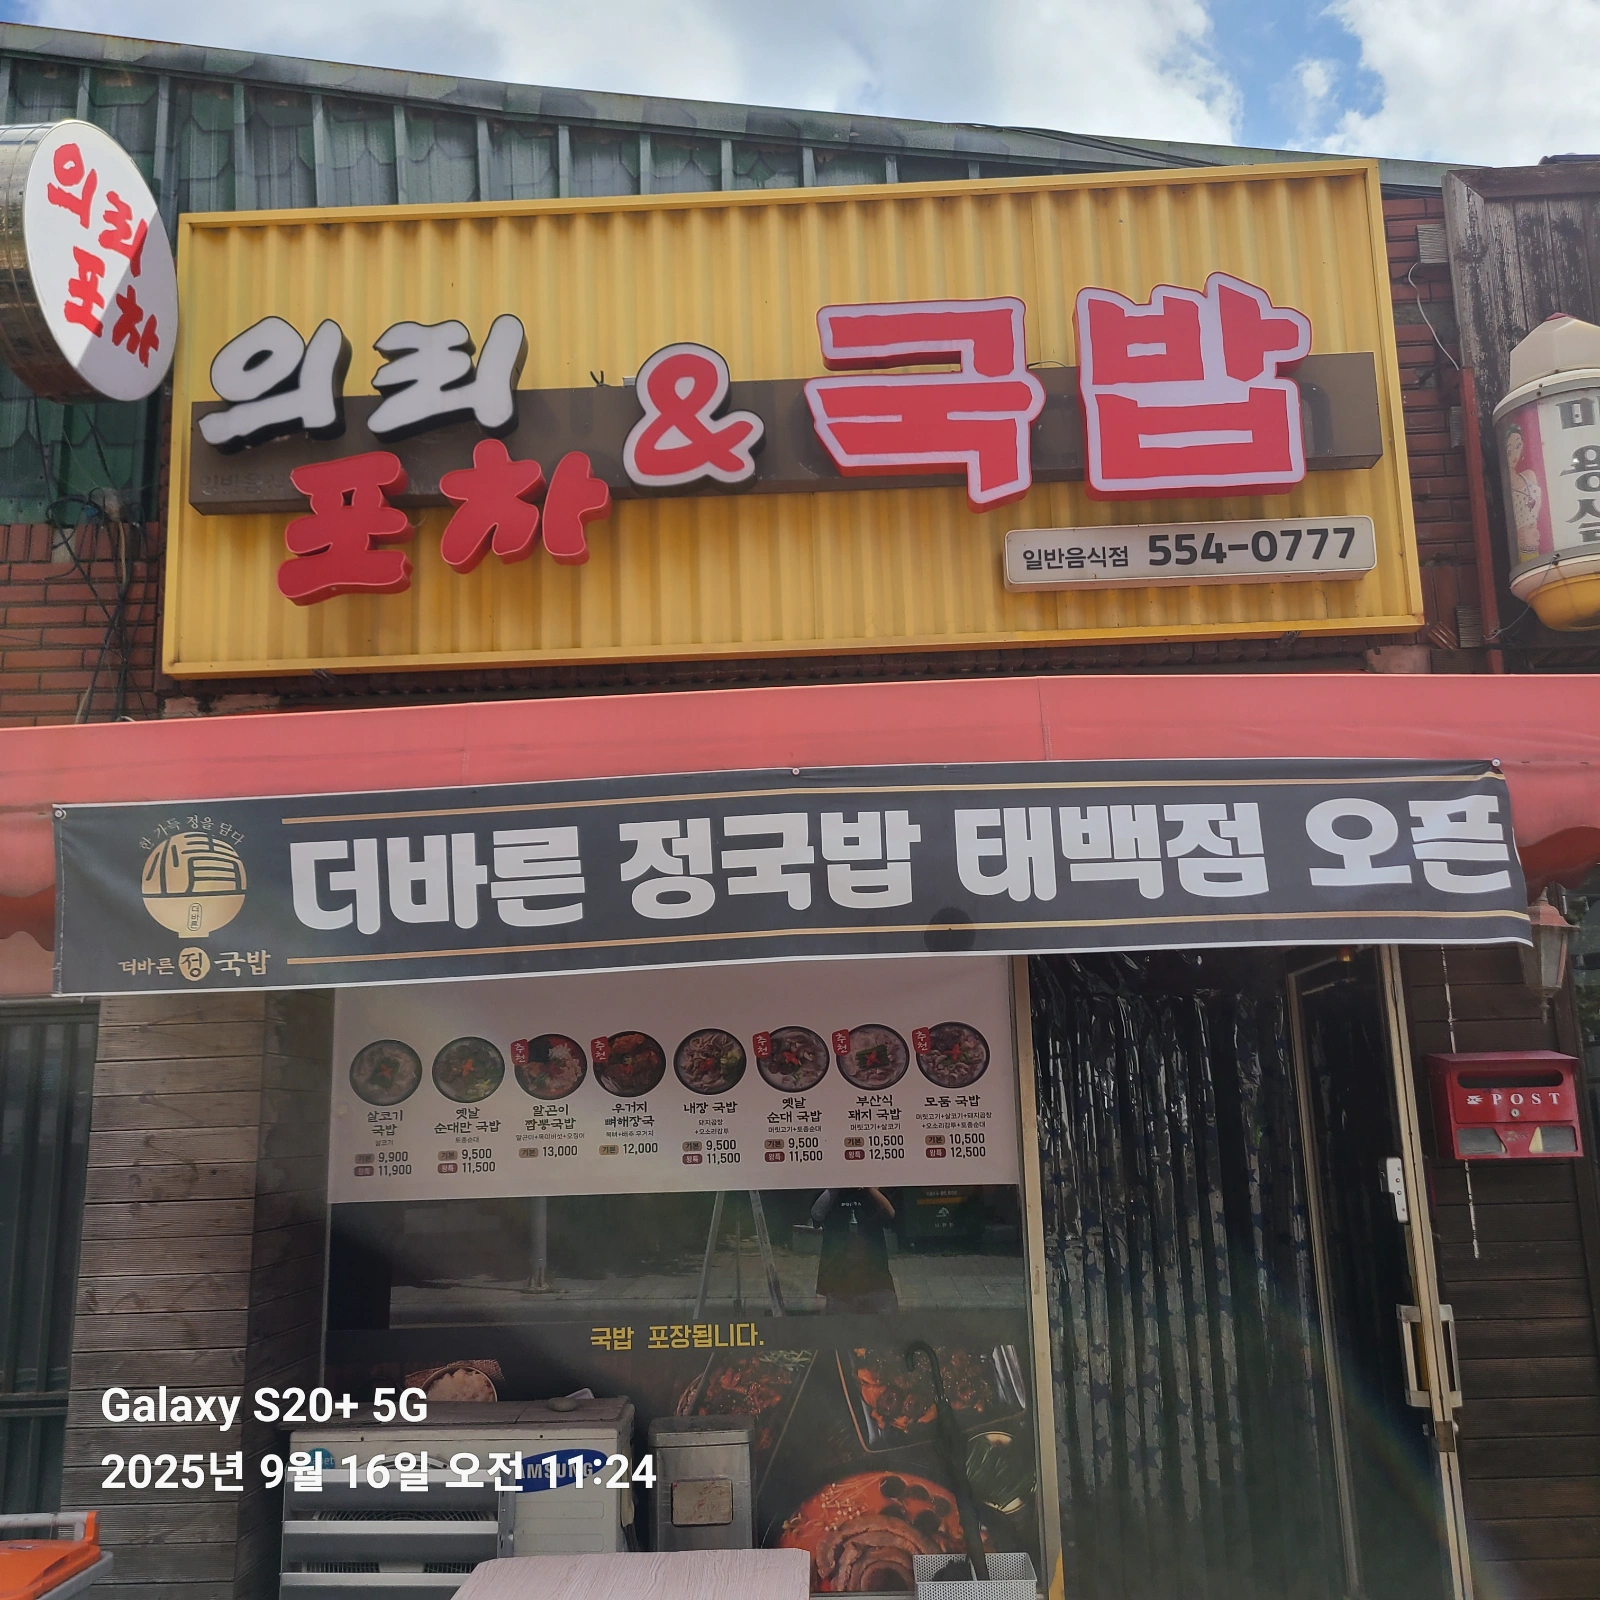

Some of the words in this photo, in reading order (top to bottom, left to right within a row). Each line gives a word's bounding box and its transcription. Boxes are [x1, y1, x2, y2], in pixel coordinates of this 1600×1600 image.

[47, 143, 149, 278] 의리
[64, 246, 159, 368] 포차
[198, 314, 525, 447] 의리
[623, 342, 765, 487] &
[804, 271, 1312, 504] 국밥
[277, 439, 611, 605] 포차
[1022, 545, 1129, 570] 일반음식점
[1147, 527, 1356, 567] 554-0777
[154, 817, 181, 838] 가득
[187, 815, 214, 831] 정을
[219, 822, 245, 846] 담다
[289, 826, 586, 935] 더바른
[619, 809, 922, 919] 정국밥
[954, 801, 1270, 902] 태백점
[1305, 795, 1512, 894] 오픈
[118, 957, 176, 976] 더바른
[214, 949, 271, 977] 국밥
[782, 1097, 807, 1109] 옛날
[856, 1094, 893, 1106] 부산식
[924, 1095, 951, 1108] 모둠
[955, 1094, 981, 1107] 국밥
[1491, 1092, 1560, 1105] POST
[456, 1107, 480, 1120] 옛날
[533, 1104, 568, 1117] 알곤이
[612, 1101, 647, 1113] 우거지
[683, 1102, 709, 1114] 내장
[712, 1101, 738, 1113] 국밥
[367, 1110, 403, 1122] 살코기
[767, 1111, 792, 1123] 순대
[796, 1110, 822, 1122] 국밥
[848, 1108, 872, 1121] 돼지
[876, 1108, 902, 1120] 국밥
[434, 1121, 472, 1134] 순대만
[476, 1120, 501, 1132] 국밥
[525, 1117, 576, 1131] 짬뽕국밥
[604, 1115, 655, 1128] 뼈해장국
[371, 1124, 398, 1136] 국밥
[706, 1139, 737, 1151] 9,500
[788, 1137, 819, 1149] 9,500
[868, 1135, 904, 1147] 10,500
[949, 1132, 985, 1145] 10,500
[462, 1148, 492, 1161] 9,500
[543, 1145, 578, 1157] 13,000
[623, 1142, 658, 1155] 12,000
[869, 1148, 905, 1161] 12,500
[950, 1146, 986, 1159] 12,500
[379, 1151, 408, 1163] 9,900
[707, 1152, 741, 1165] 11,500
[789, 1150, 823, 1163] 11,500
[379, 1164, 412, 1177] 11,900
[462, 1161, 496, 1174] 11,500
[590, 1326, 634, 1350] 국밥
[647, 1322, 765, 1349] 포장됩니다.
